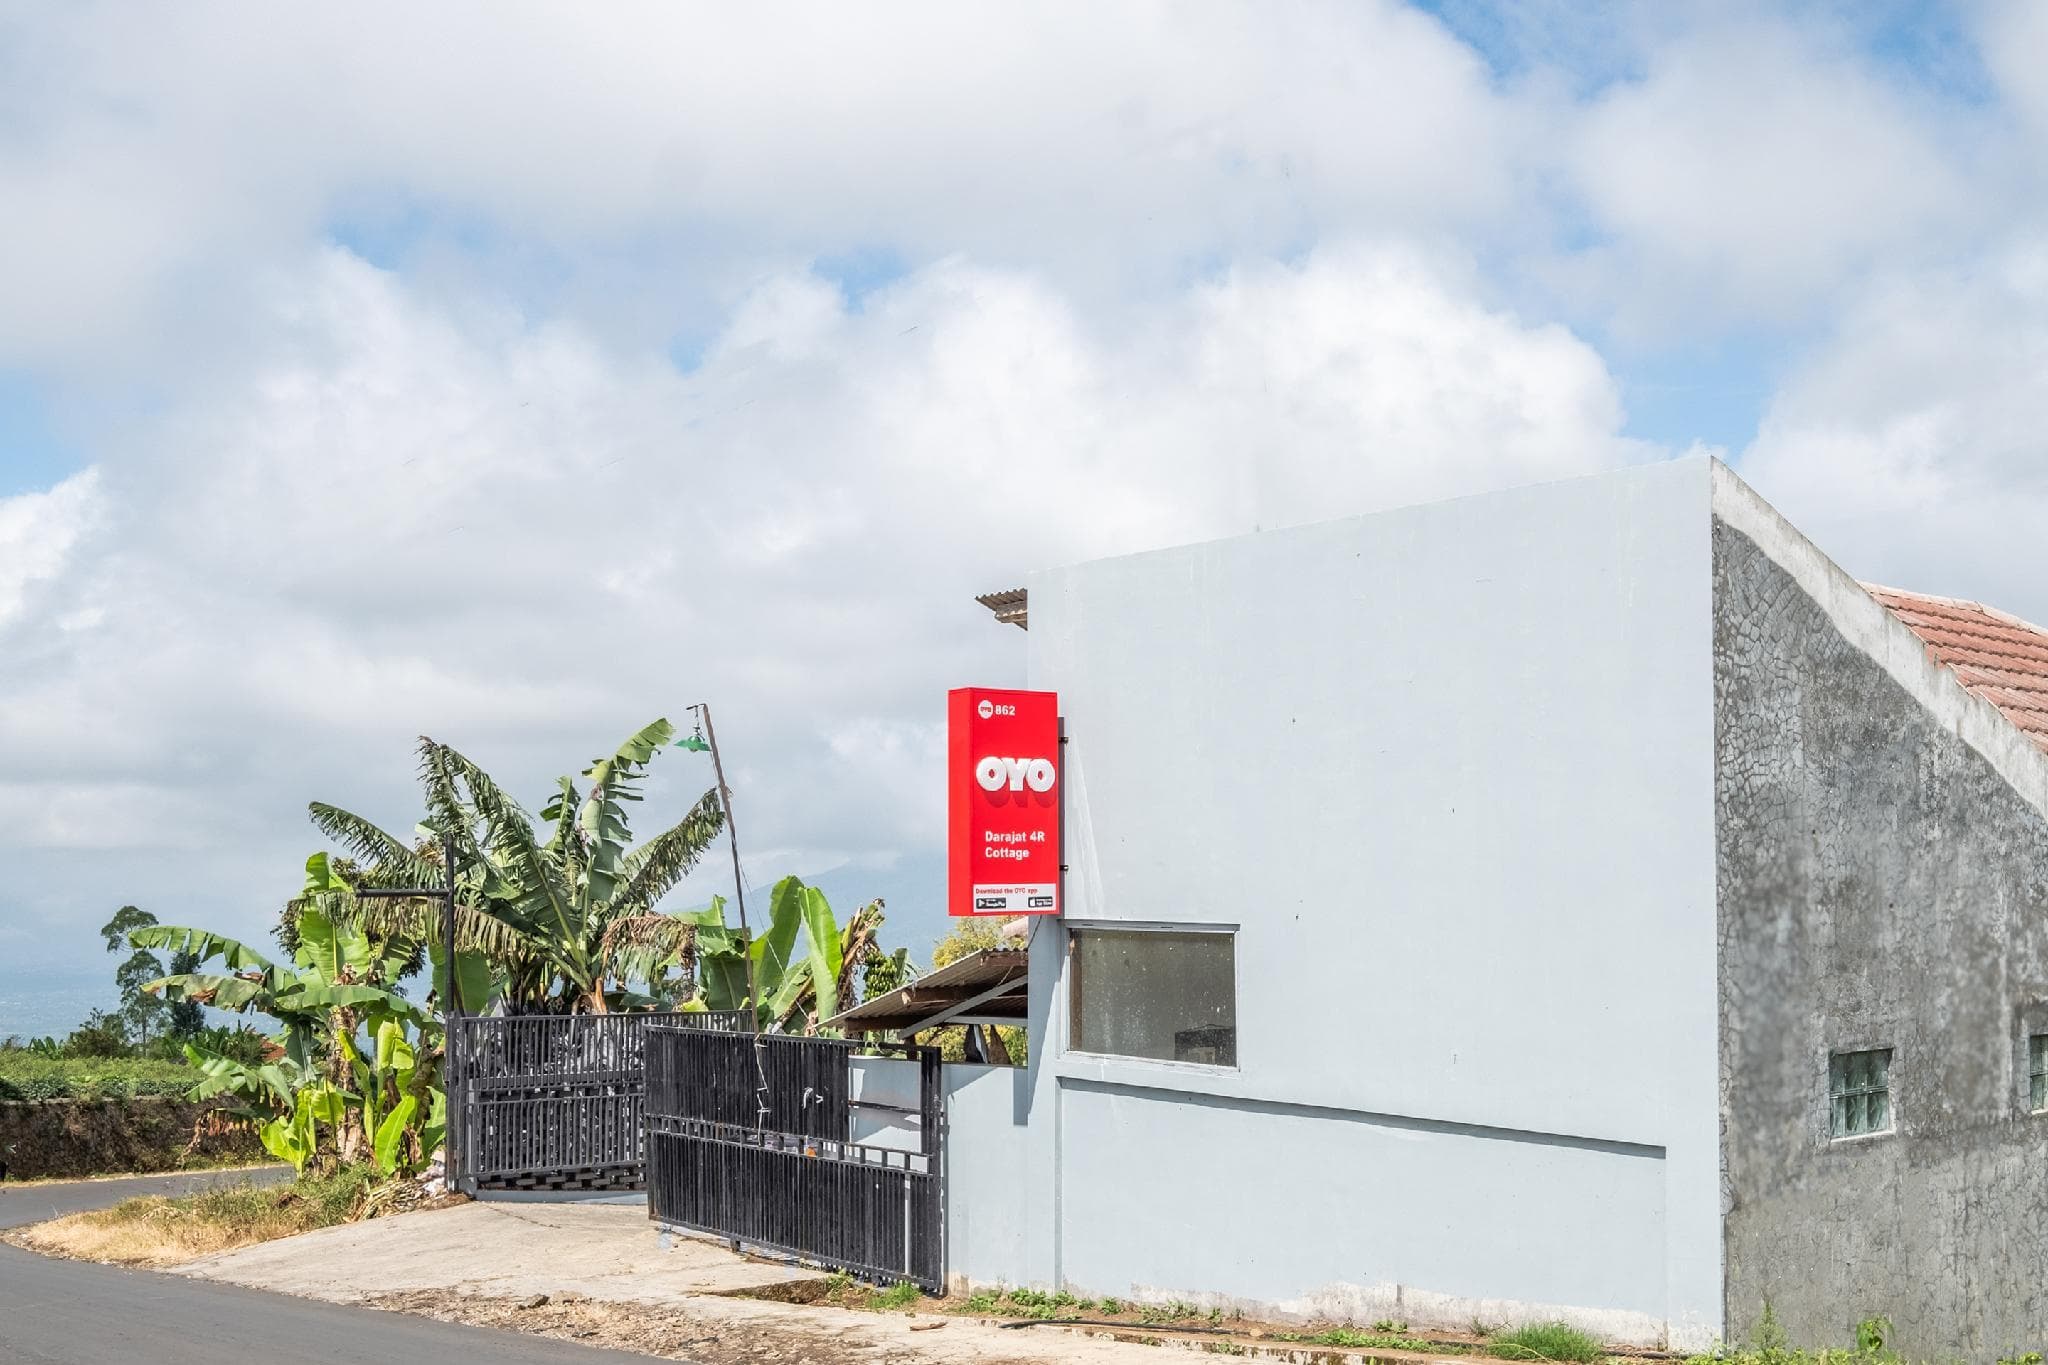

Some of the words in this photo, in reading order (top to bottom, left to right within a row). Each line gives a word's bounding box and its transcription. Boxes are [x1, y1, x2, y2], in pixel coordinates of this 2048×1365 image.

[995, 704, 1016, 716] 862
[975, 757, 1056, 792] OYO
[985, 831, 1027, 846] Darajat
[1029, 831, 1045, 842] 4R
[985, 847, 1030, 861] Cottage
